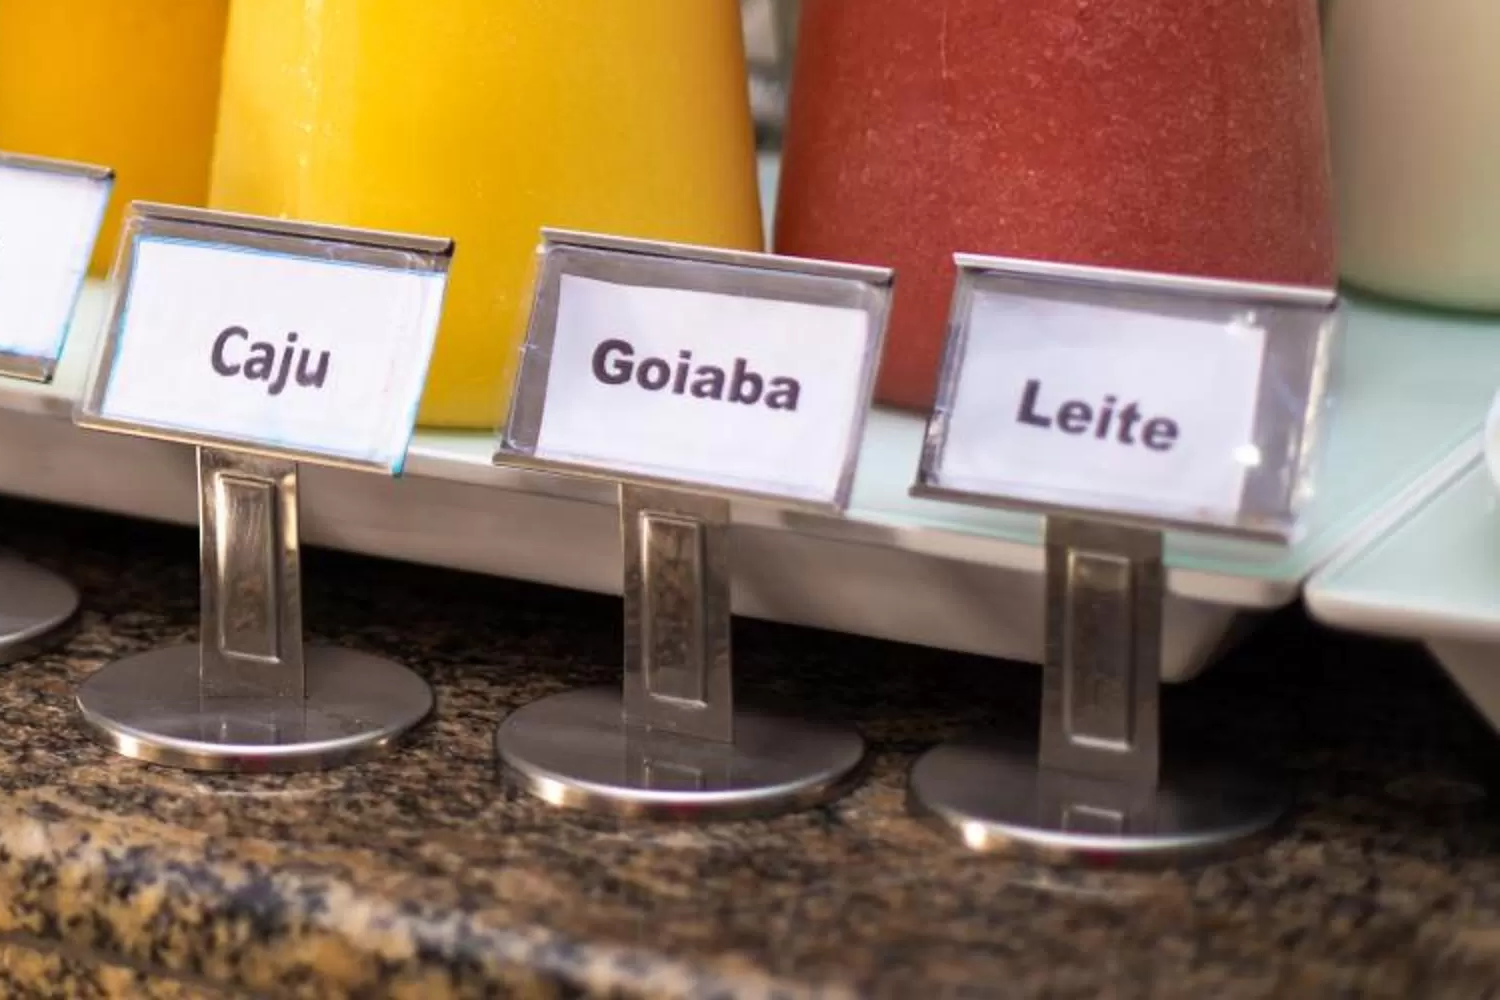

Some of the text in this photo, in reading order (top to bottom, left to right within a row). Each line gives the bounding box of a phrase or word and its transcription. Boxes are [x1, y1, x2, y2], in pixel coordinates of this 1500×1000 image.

[211, 325, 331, 396] Caju
[591, 338, 801, 411] Goiaba
[1016, 379, 1180, 452] Leite
